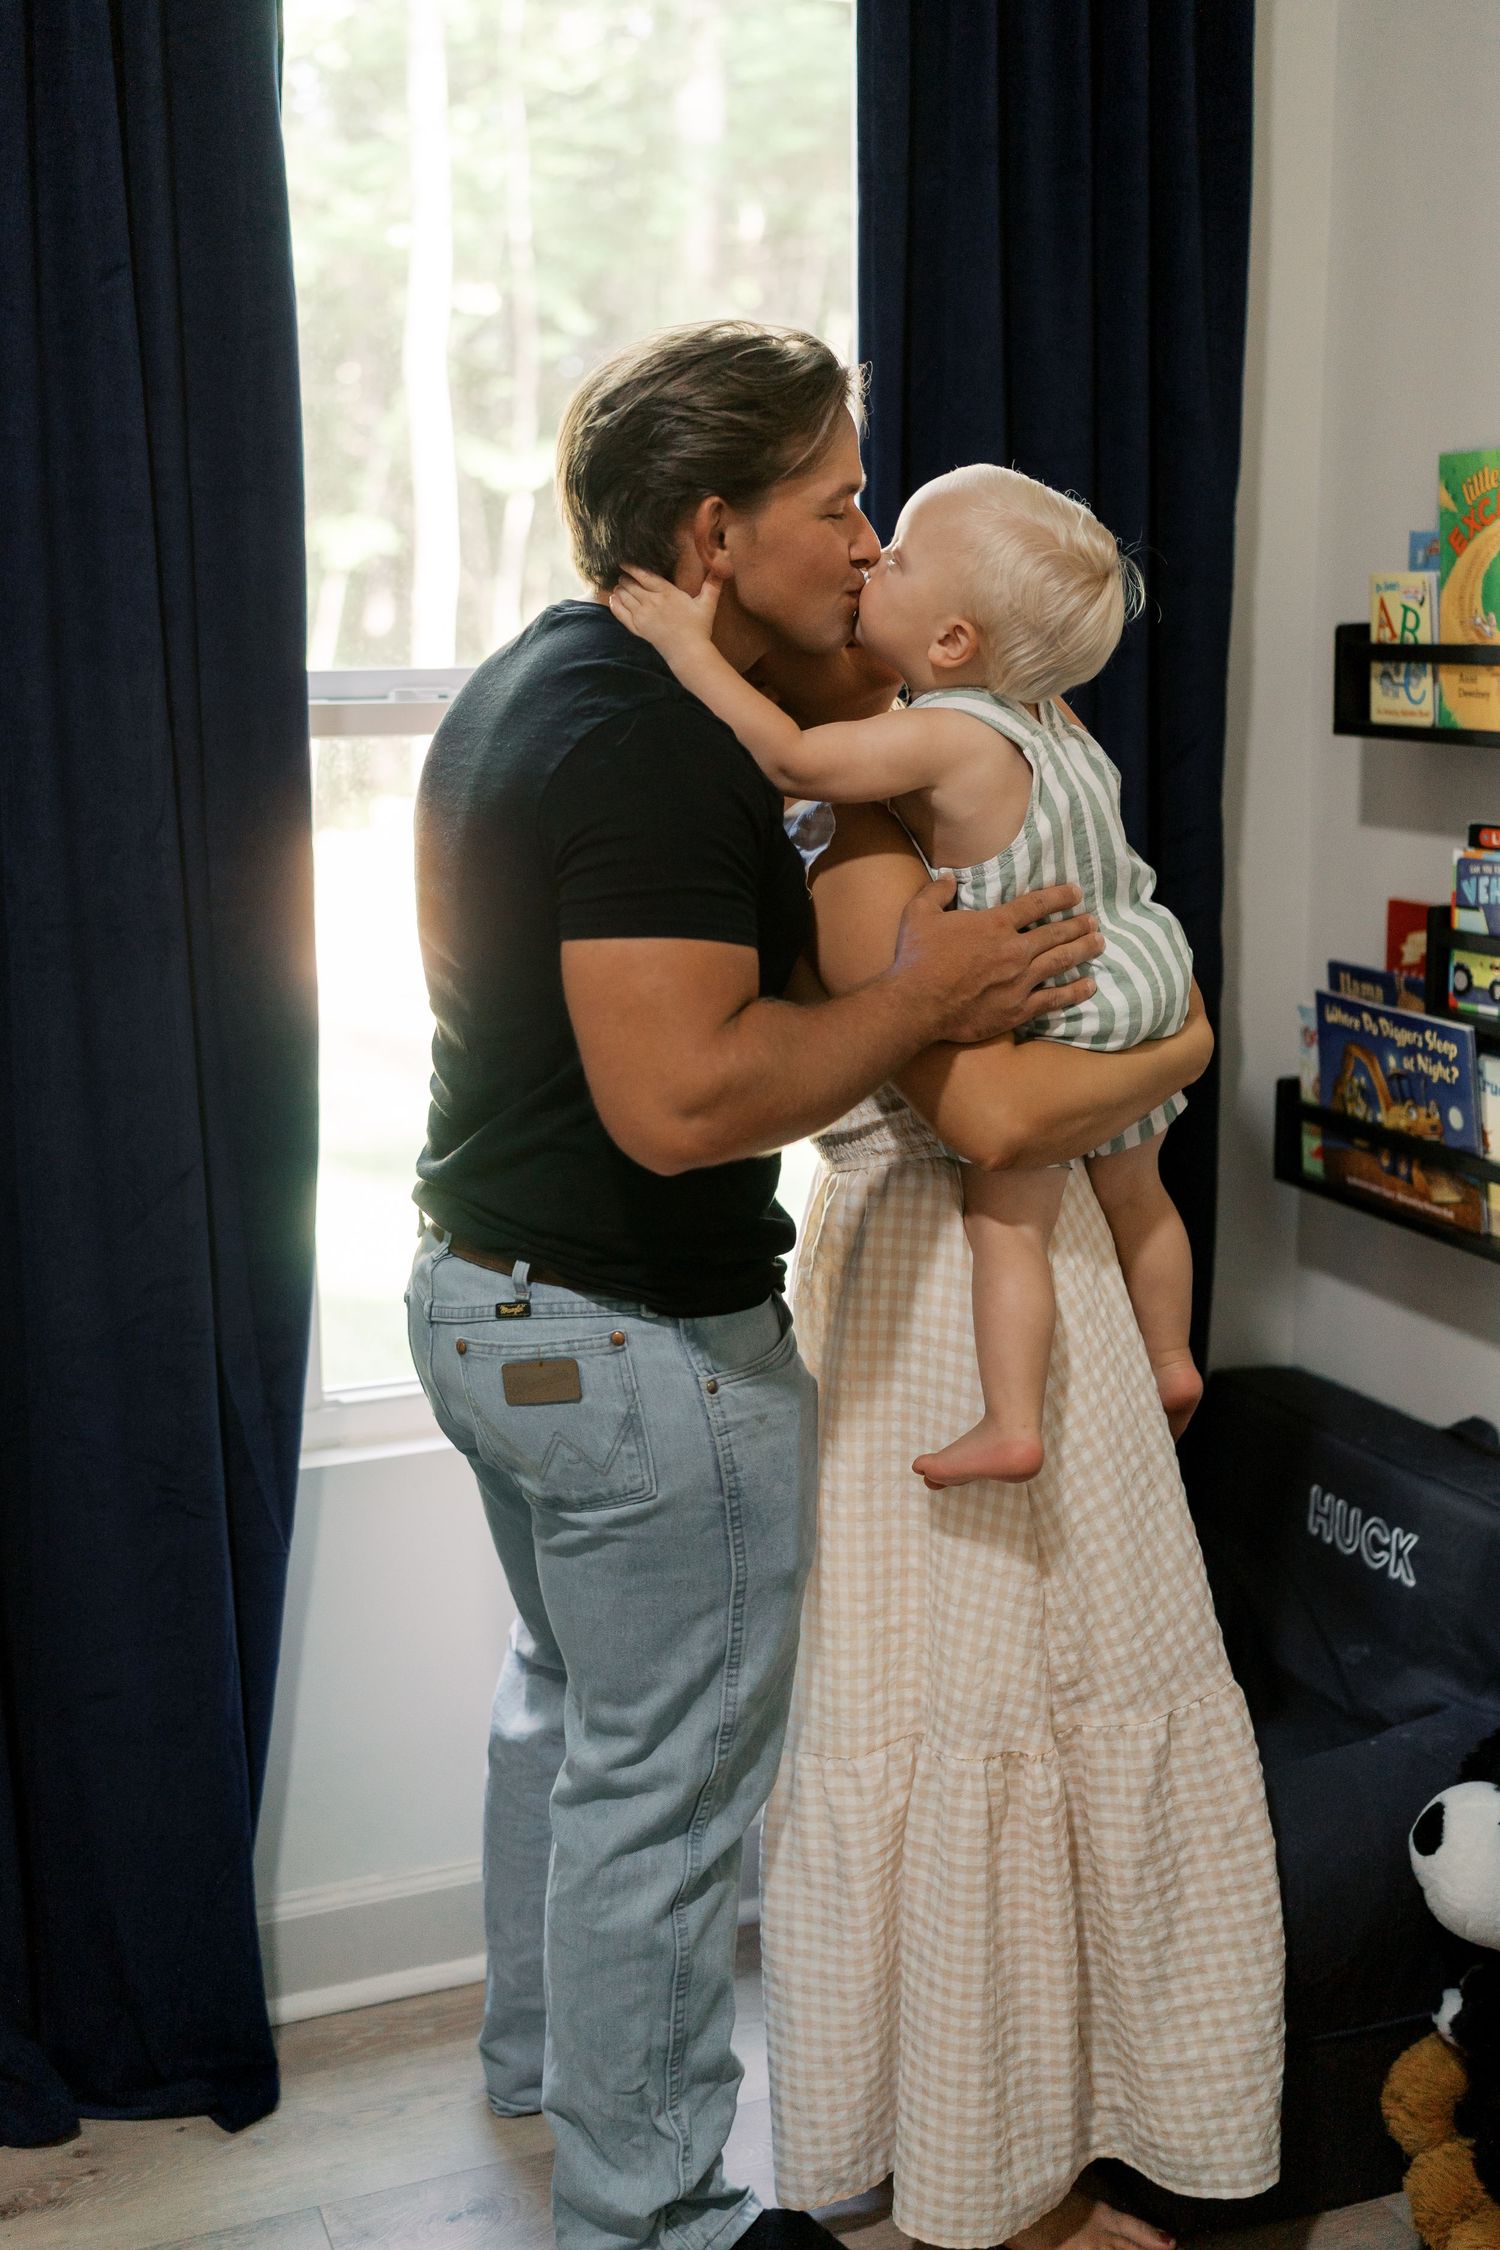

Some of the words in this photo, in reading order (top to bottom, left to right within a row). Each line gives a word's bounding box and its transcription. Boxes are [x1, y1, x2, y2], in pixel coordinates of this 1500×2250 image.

[1448, 489, 1500, 558] EXC
[1325, 1004, 1360, 1031] Where
[1362, 1011, 1378, 1036] Do
[1379, 1017, 1423, 1048] Diggers
[1425, 1029, 1457, 1062] Sleep
[1403, 1055, 1415, 1072] at
[1417, 1053, 1459, 1085] Night?
[1308, 1484, 1420, 1587] HUCK
